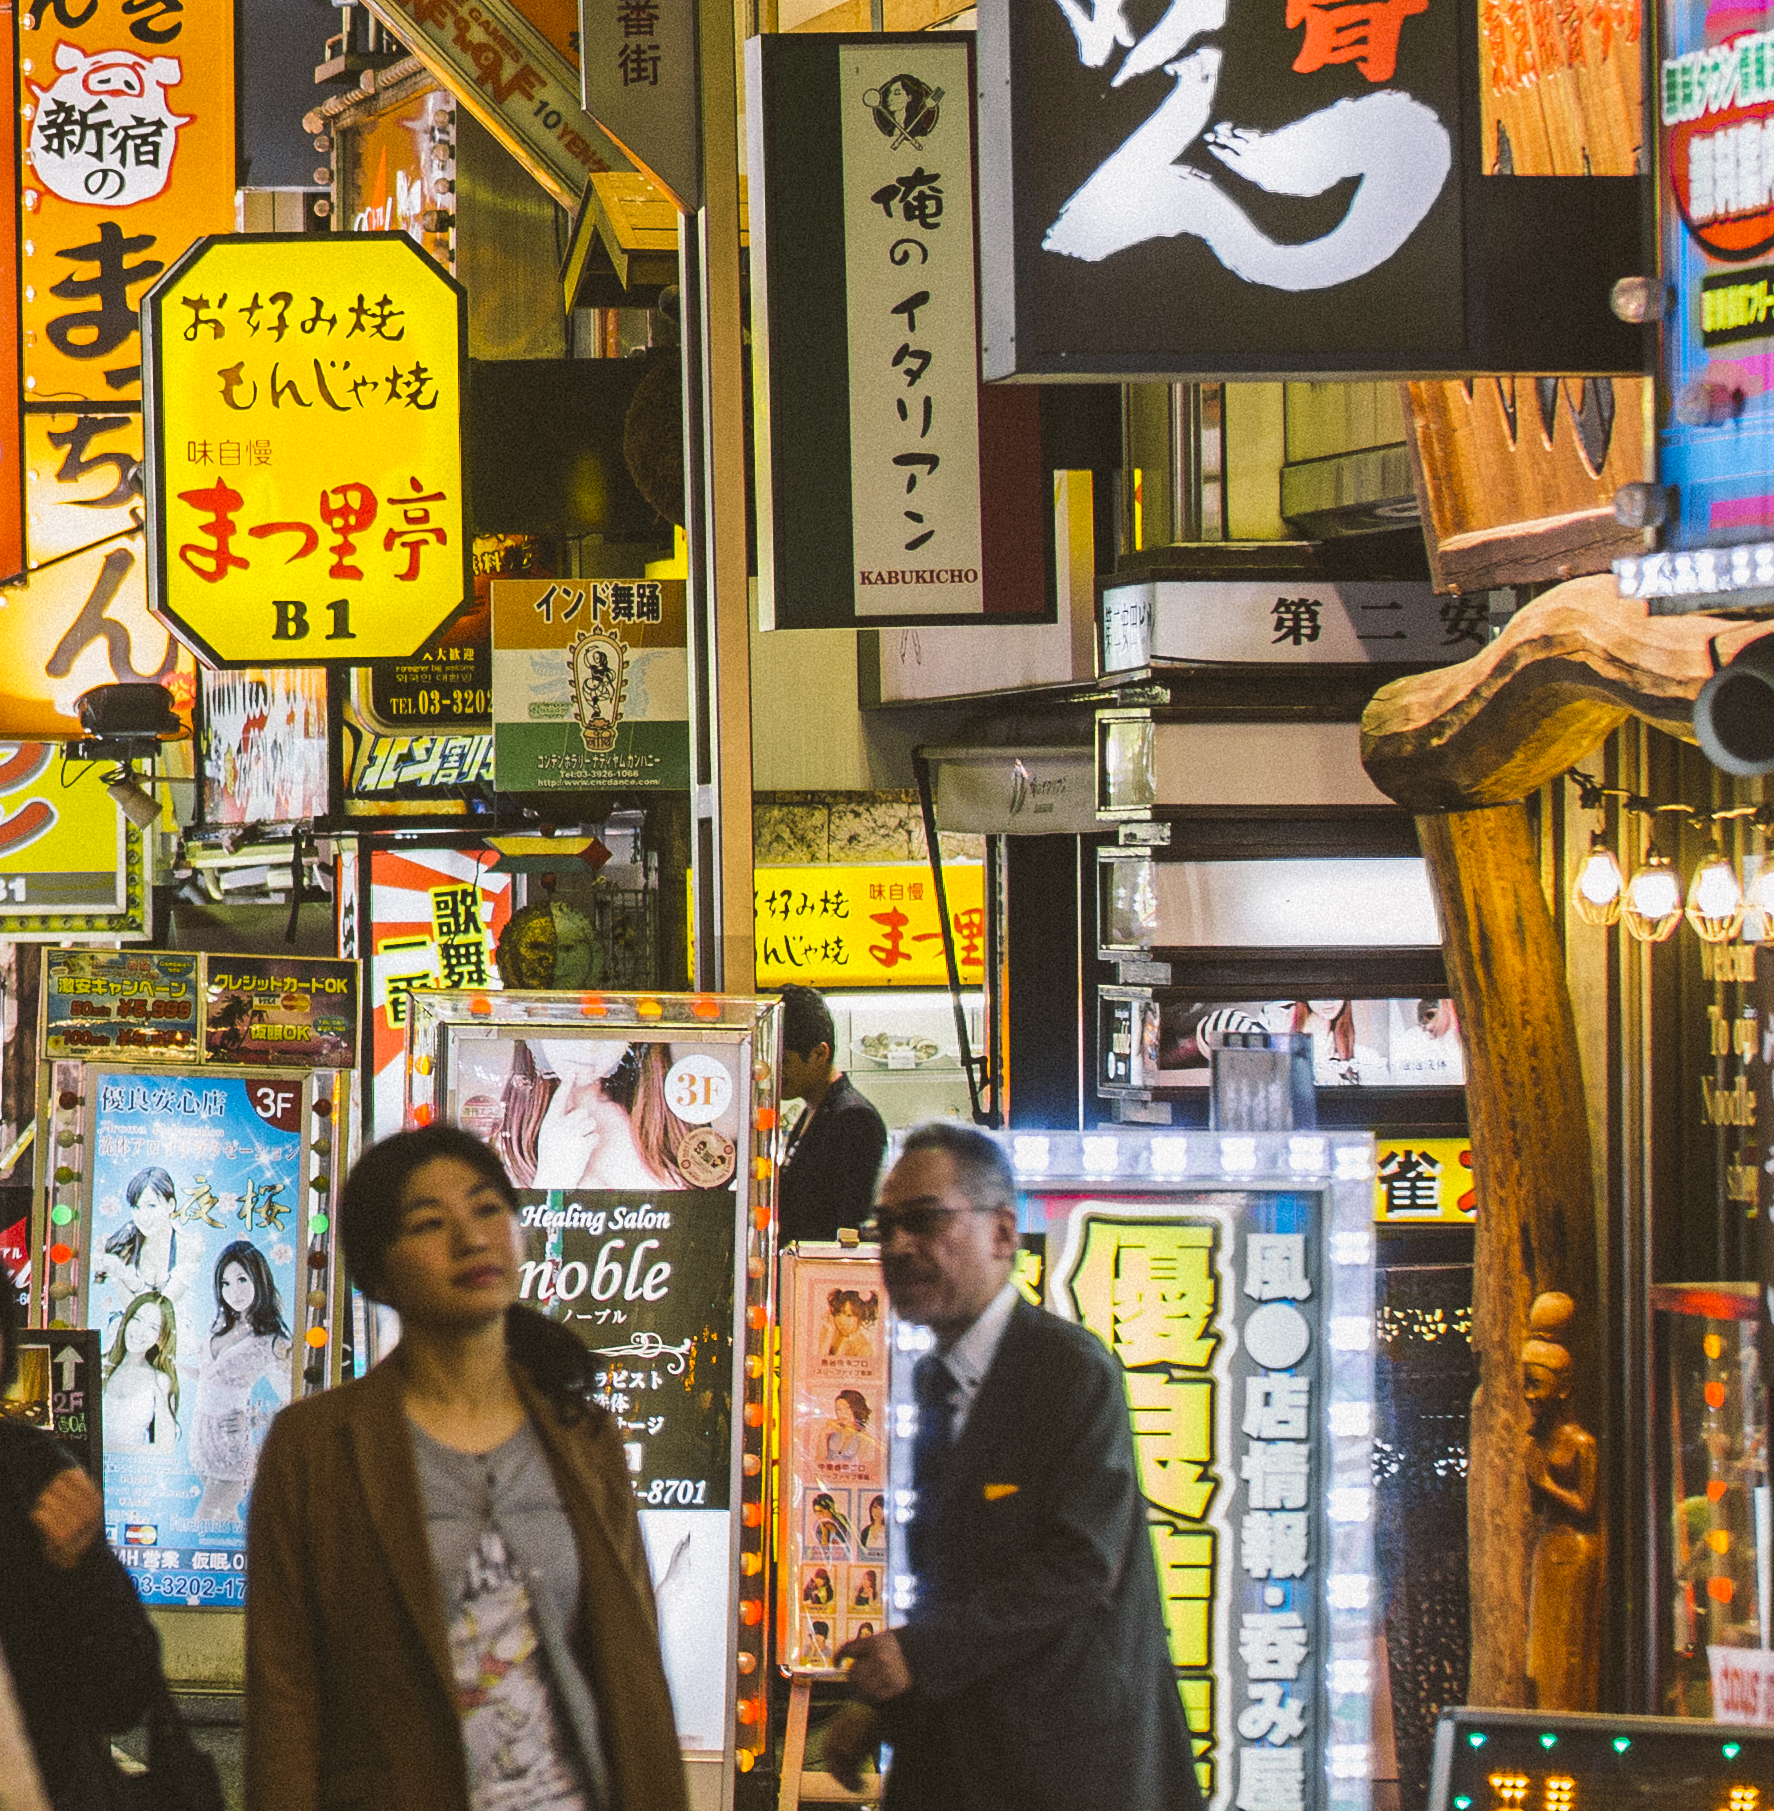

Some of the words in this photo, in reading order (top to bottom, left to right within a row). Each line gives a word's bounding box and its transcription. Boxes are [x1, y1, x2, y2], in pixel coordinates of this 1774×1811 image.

[41, 99, 170, 170] 新宿
[84, 169, 125, 200] の
[180, 291, 407, 344] お好み焼
[871, 165, 946, 552] 俺のイタリアン
[217, 359, 440, 414] もんじゃ焼
[188, 439, 274, 468] 味自慢
[177, 474, 449, 583] まつ里亭
[860, 568, 979, 586] KABUKICHO
[534, 582, 662, 623] インド舞踊
[271, 599, 358, 643] B1
[390, 698, 416, 714] TEL
[869, 882, 924, 902] 味自慢
[58, 977, 186, 997] 激安キャンペーン
[215, 975, 348, 994] クレジットカードOK
[101, 1086, 227, 1116] 優良安心店
[256, 1087, 293, 1118] 3F
[676, 1072, 726, 1107] 3F
[522, 1203, 607, 1234] Healing
[612, 1203, 670, 1231] Salon
[518, 1238, 671, 1303] noble
[562, 1309, 627, 1325] ノーブル
[143, 1549, 180, 1569] 営業
